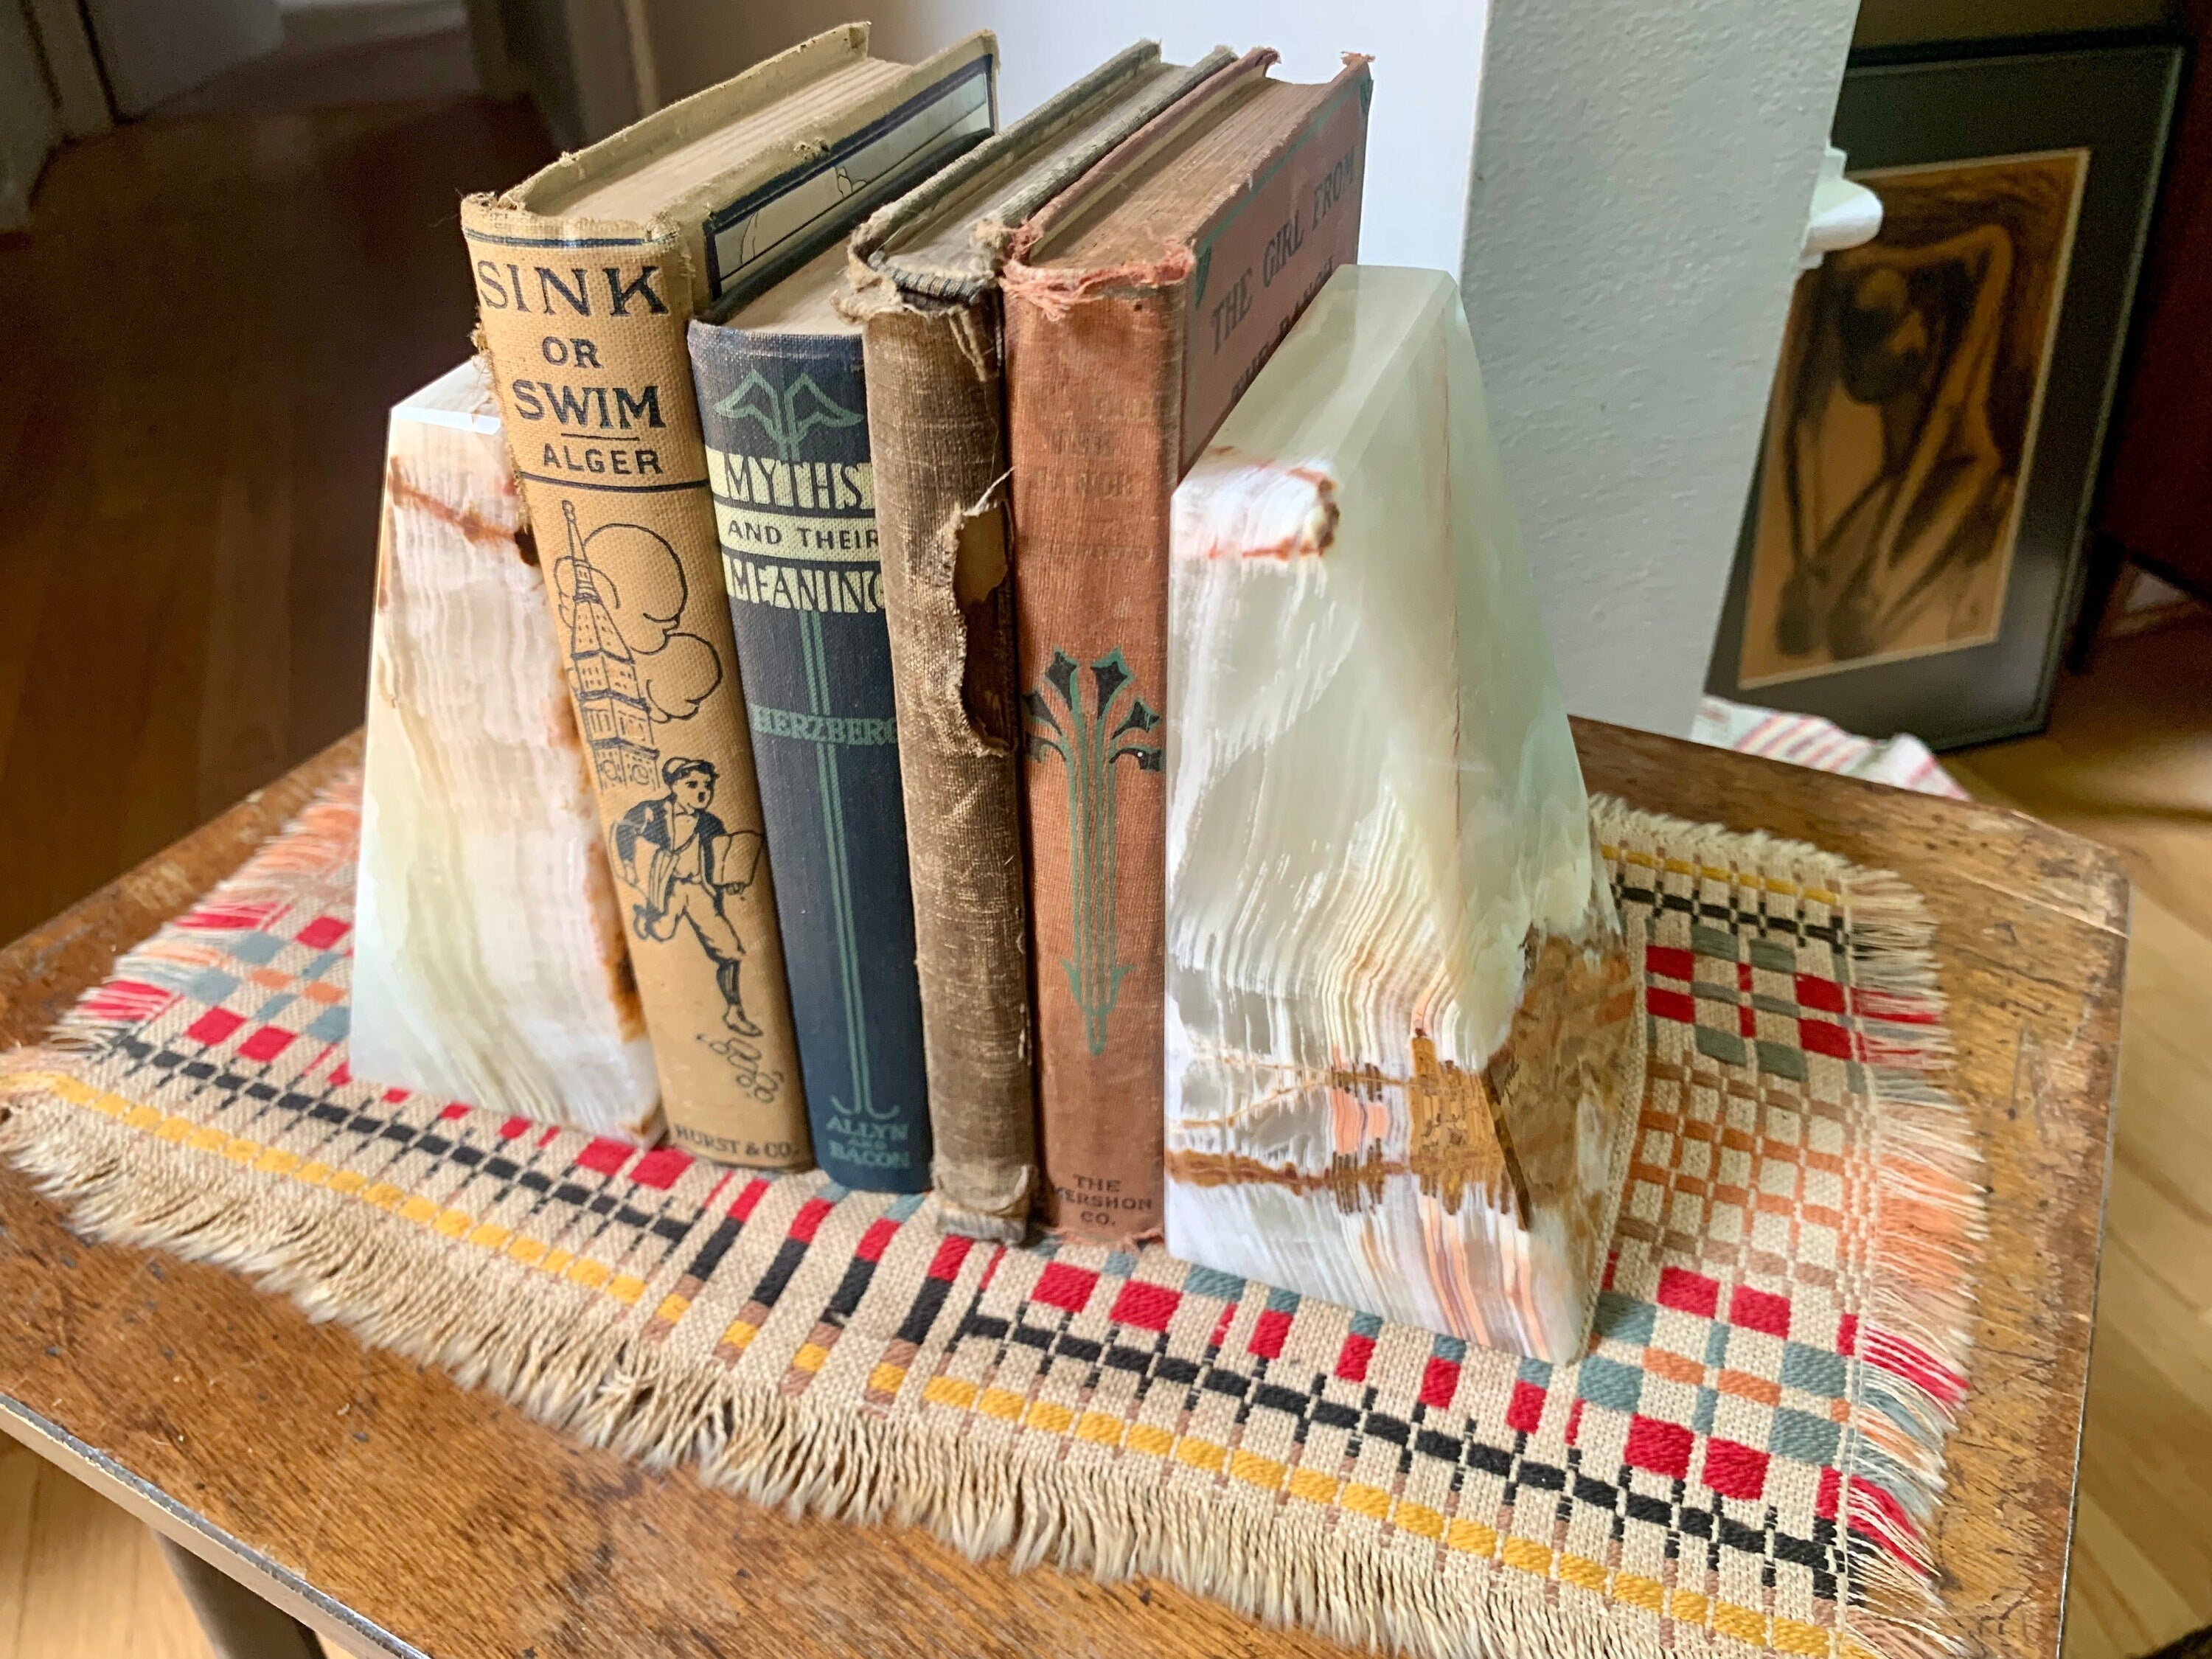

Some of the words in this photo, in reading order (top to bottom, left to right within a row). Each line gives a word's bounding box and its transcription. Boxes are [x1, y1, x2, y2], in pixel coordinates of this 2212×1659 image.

[1211, 266, 1253, 355] THE
[1262, 209, 1304, 288] GIRL
[1312, 150, 1355, 232] FROM
[477, 260, 669, 317] SINK
[541, 335, 604, 369] OR
[512, 378, 667, 429] SWIM
[543, 442, 664, 475] ALGER
[723, 453, 862, 509] MYTHS
[728, 519, 782, 545] AND
[796, 526, 879, 550] THEIR
[674, 1123, 740, 1154] HURST
[745, 1141, 760, 1156] &
[826, 1115, 908, 1141] ALLYN
[828, 1138, 910, 1168] BACON
[1072, 1172, 1121, 1192] THE
[1079, 1210, 1116, 1227] CO.
